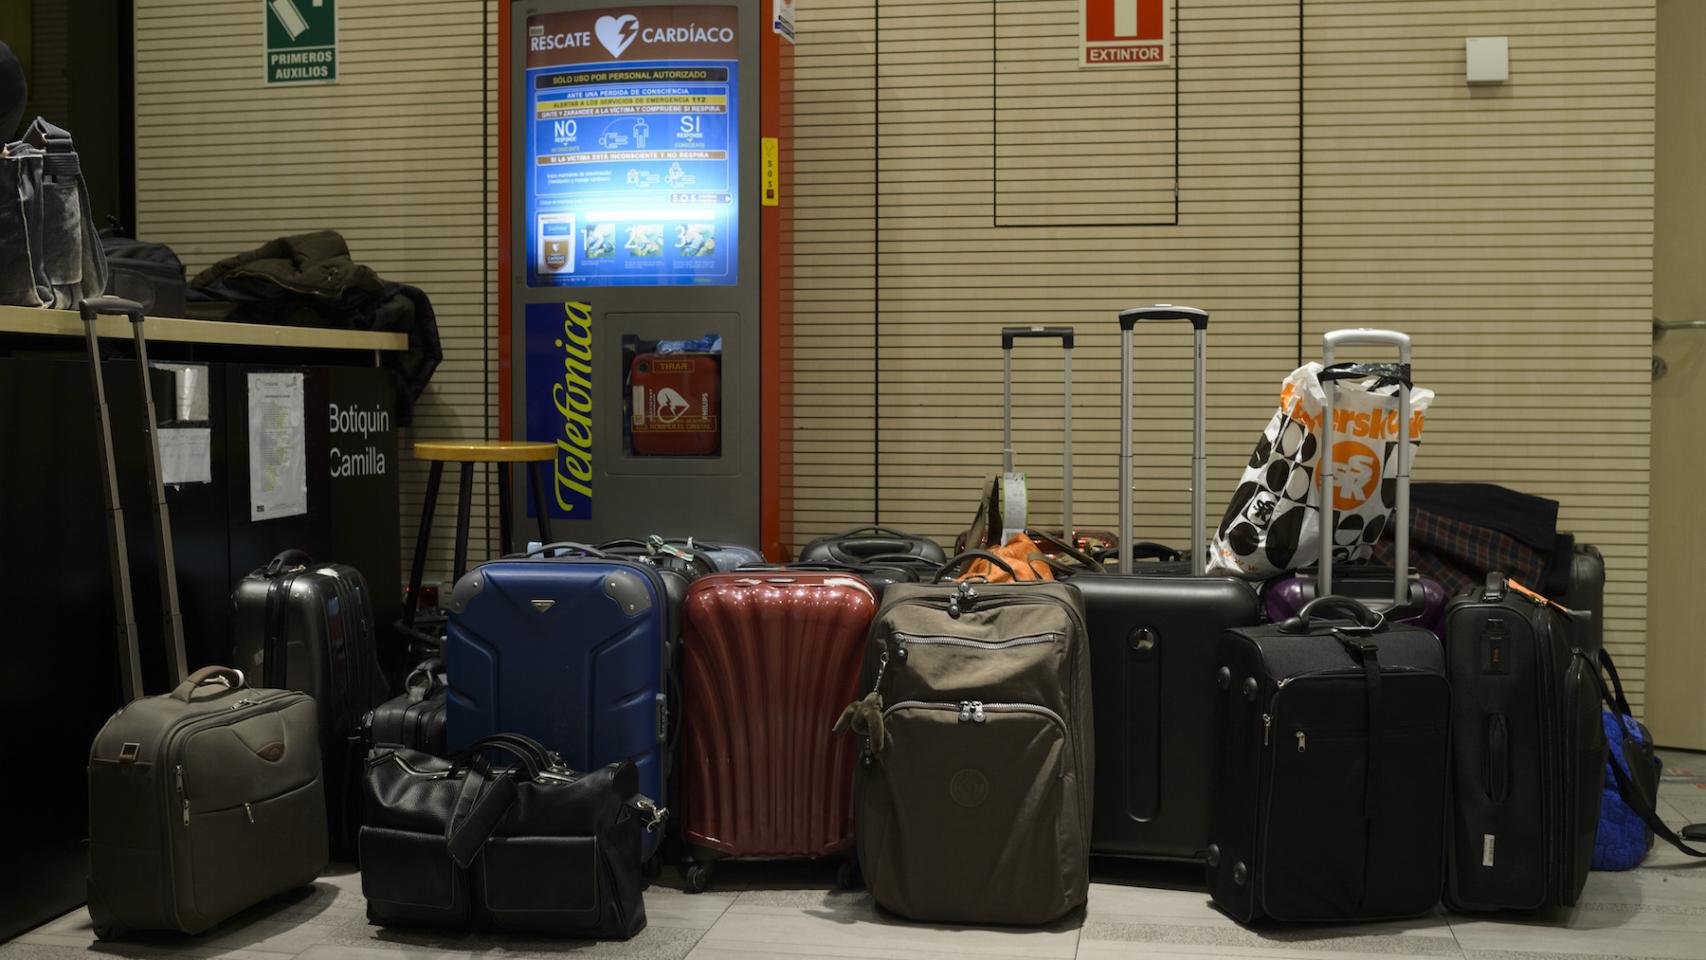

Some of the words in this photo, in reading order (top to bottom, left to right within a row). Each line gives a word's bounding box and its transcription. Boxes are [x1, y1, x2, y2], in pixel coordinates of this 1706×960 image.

[531, 31, 591, 51] RESCATE
[642, 23, 734, 43] CARDÍACO
[271, 51, 333, 65] PRIMEROS
[1090, 47, 1160, 61] EXTINTOR
[275, 65, 329, 80] AUXILIOS
[573, 74, 589, 83] USO
[591, 73, 606, 82] POR
[608, 71, 652, 81] PERSONAL
[653, 70, 707, 80] AUTORIZADO
[567, 91, 584, 99] ANTE
[585, 90, 598, 98] UNA
[630, 88, 640, 96] DE
[641, 87, 689, 96] CONSCIENCIA
[554, 119, 577, 137] NO
[680, 115, 700, 133] SI
[624, 226, 638, 248] 2
[674, 225, 687, 248] 3
[329, 446, 386, 478] Camilla
